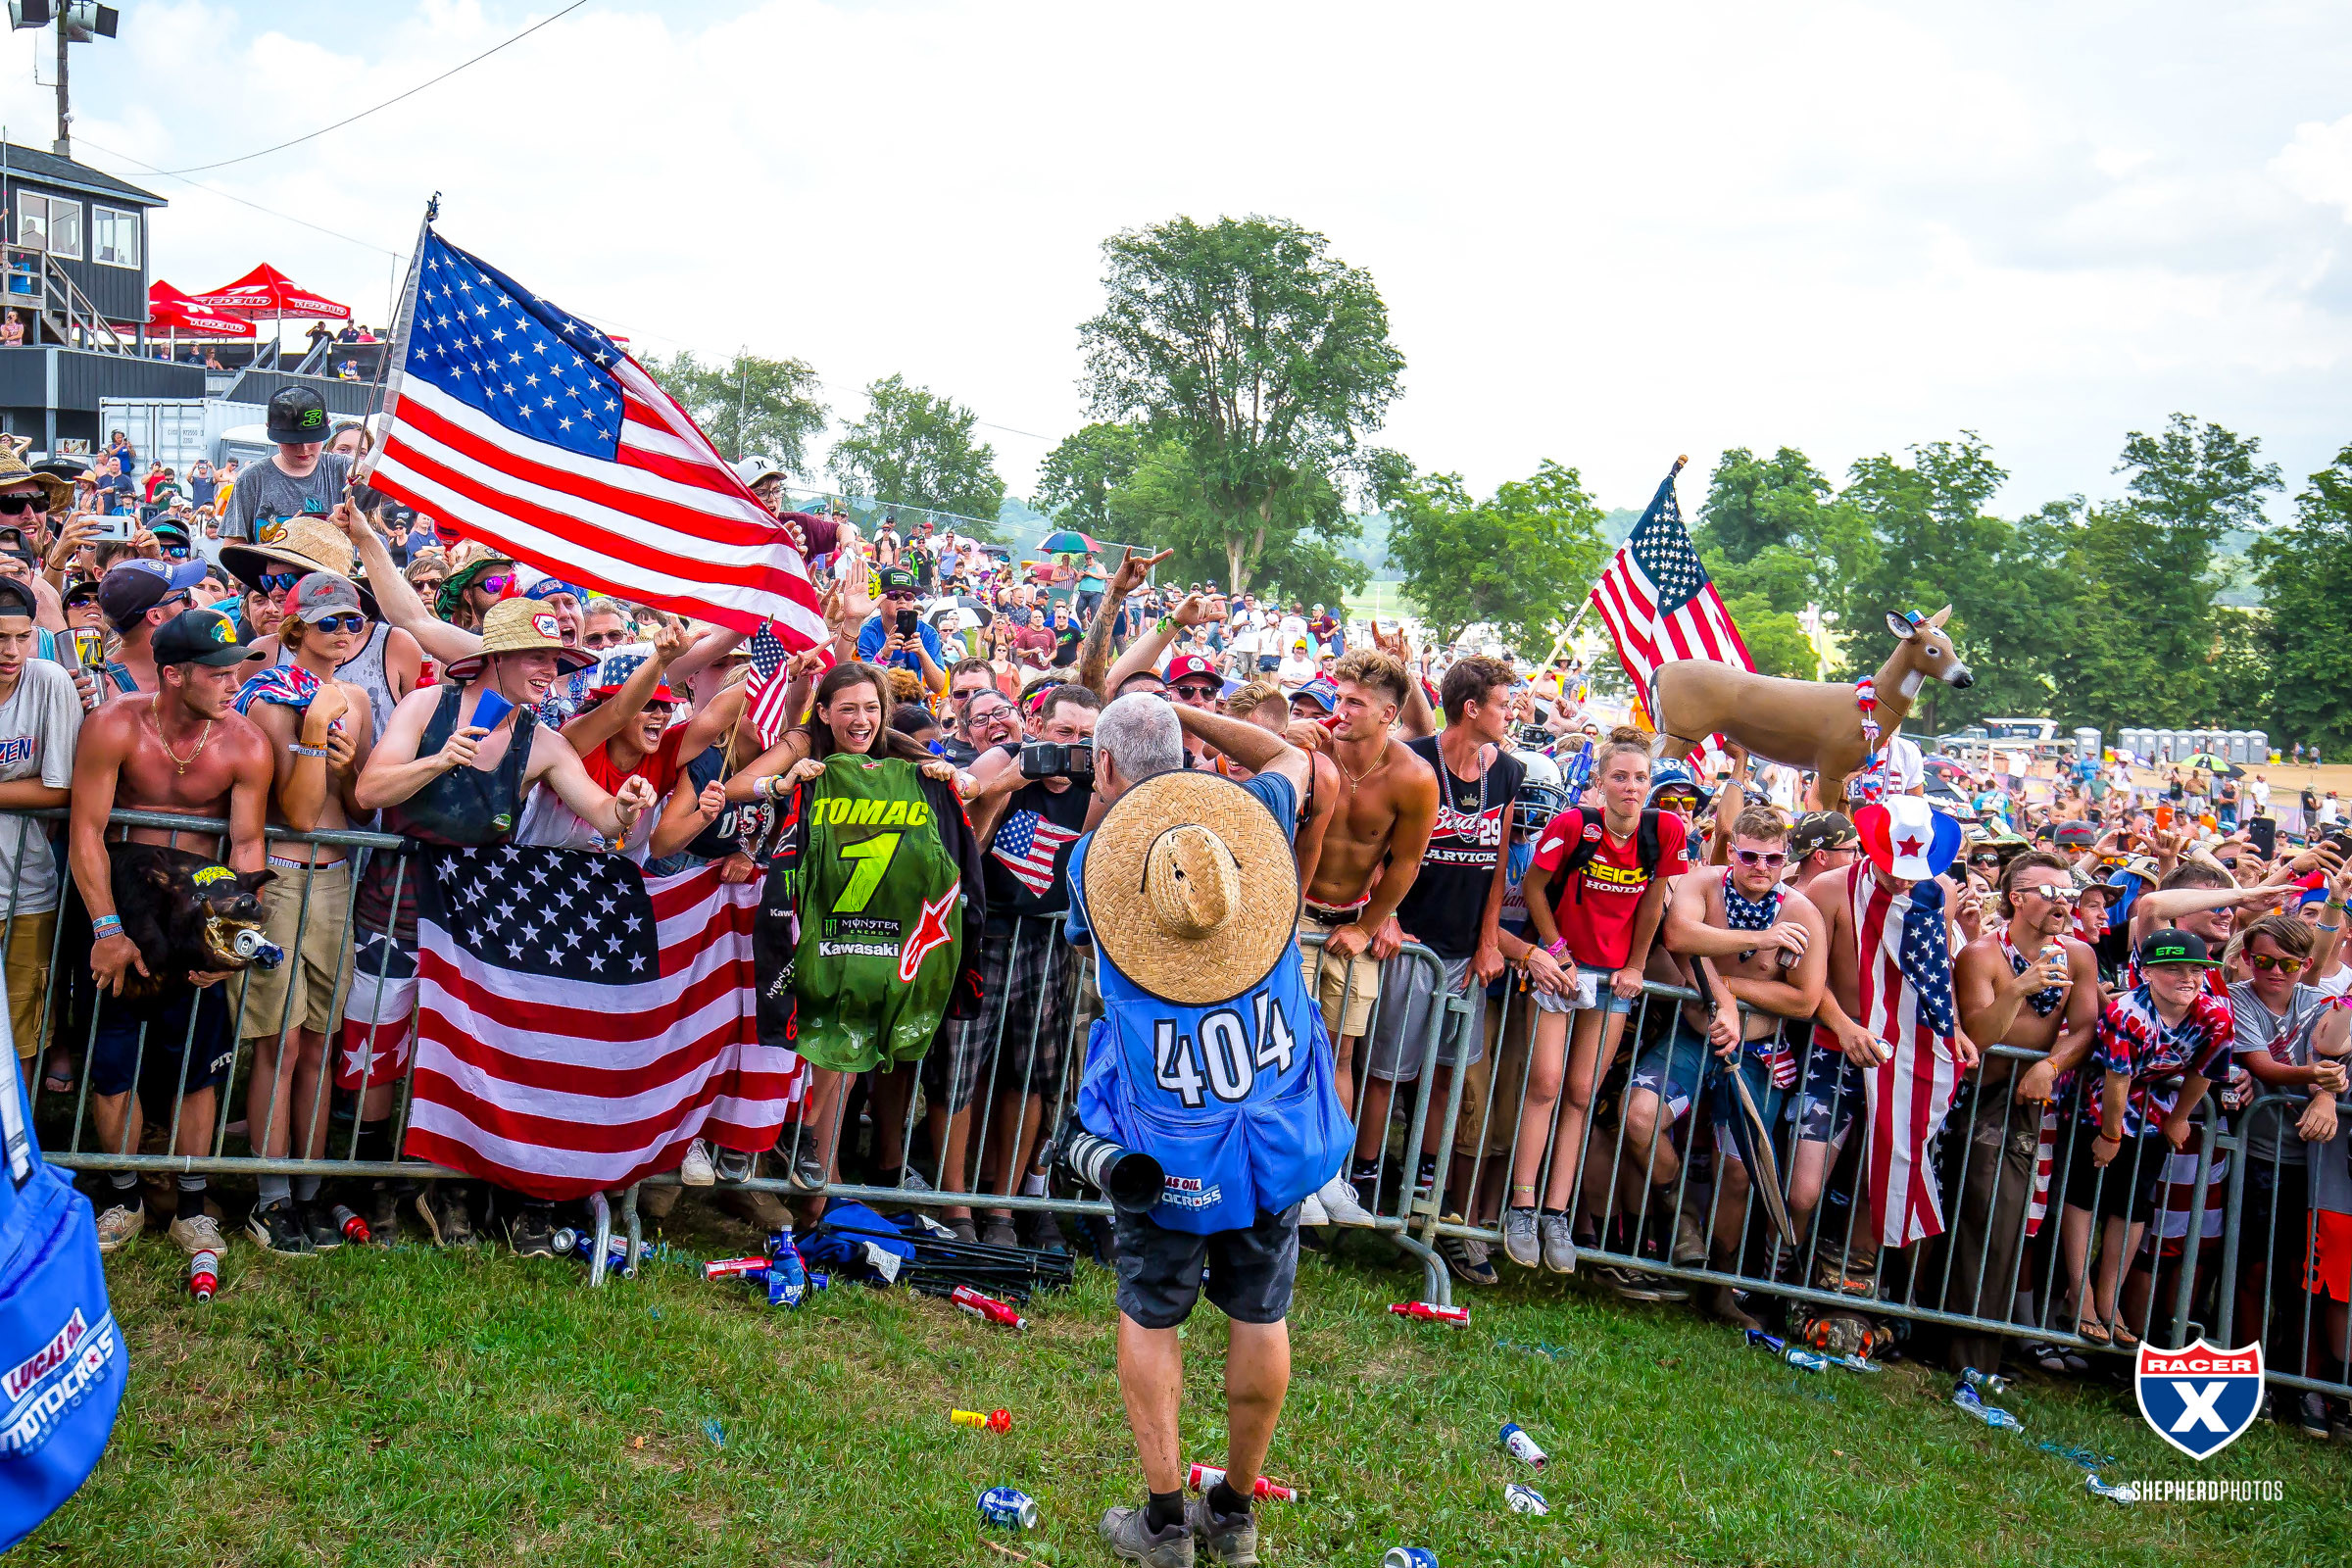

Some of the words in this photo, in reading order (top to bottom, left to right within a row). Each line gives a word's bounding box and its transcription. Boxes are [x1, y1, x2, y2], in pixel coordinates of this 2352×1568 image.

[812, 797, 929, 827] TOMAC
[1479, 817, 1501, 847] 29
[1423, 849, 1497, 862] ARVICK
[1585, 879, 1645, 894] HONDA
[842, 919, 899, 930] MONSTER
[818, 942, 901, 957] Kawasaki
[1153, 988, 1297, 1108] 404
[1182, 1179, 1200, 1191] OIL
[11, 1335, 66, 1397] LUCAS
